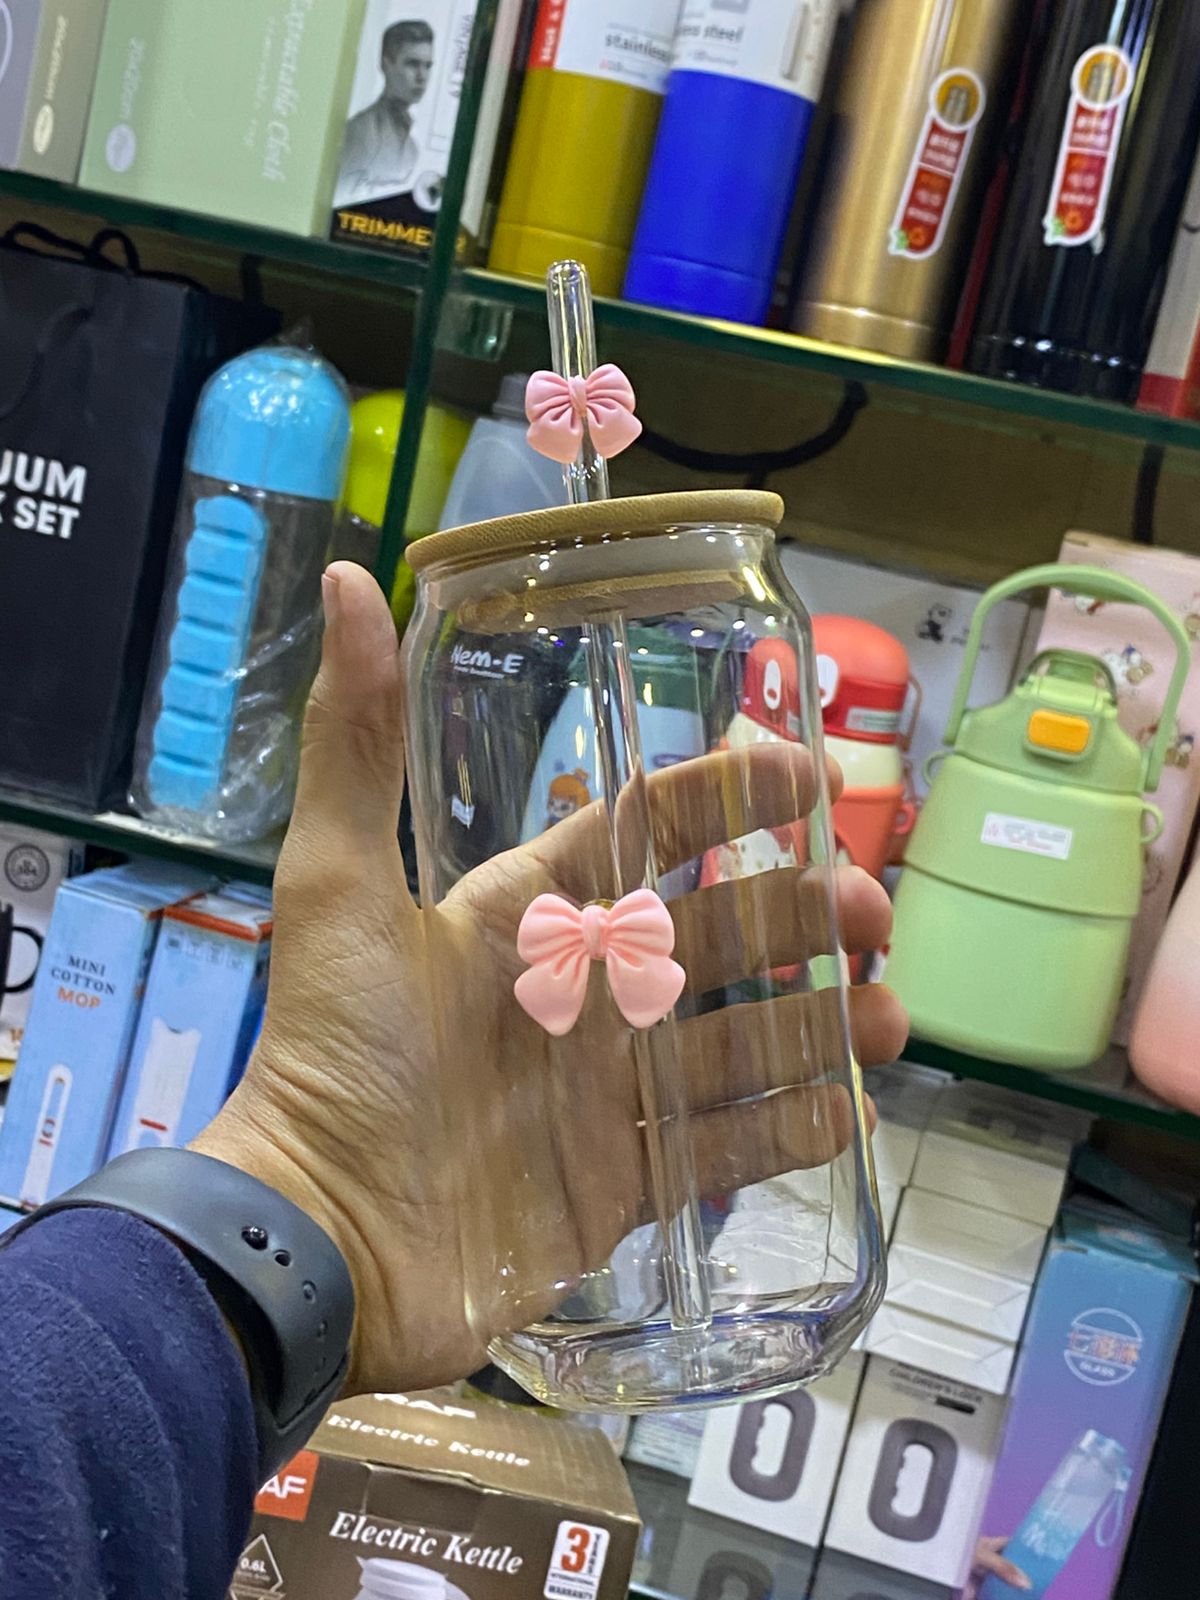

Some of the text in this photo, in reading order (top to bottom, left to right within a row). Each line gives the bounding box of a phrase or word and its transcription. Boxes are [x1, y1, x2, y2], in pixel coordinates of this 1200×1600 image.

[338, 211, 434, 248] TRIMME
[13, 495, 80, 539] SET
[51, 966, 116, 995] COTTON
[68, 955, 106, 978] MINI
[58, 985, 101, 1010] MOP
[327, 1414, 531, 1467] Electric Kettle
[328, 1511, 524, 1575] Electric Kettle
[561, 1526, 591, 1573] 3
[548, 1585, 593, 1600] WARRANTY
